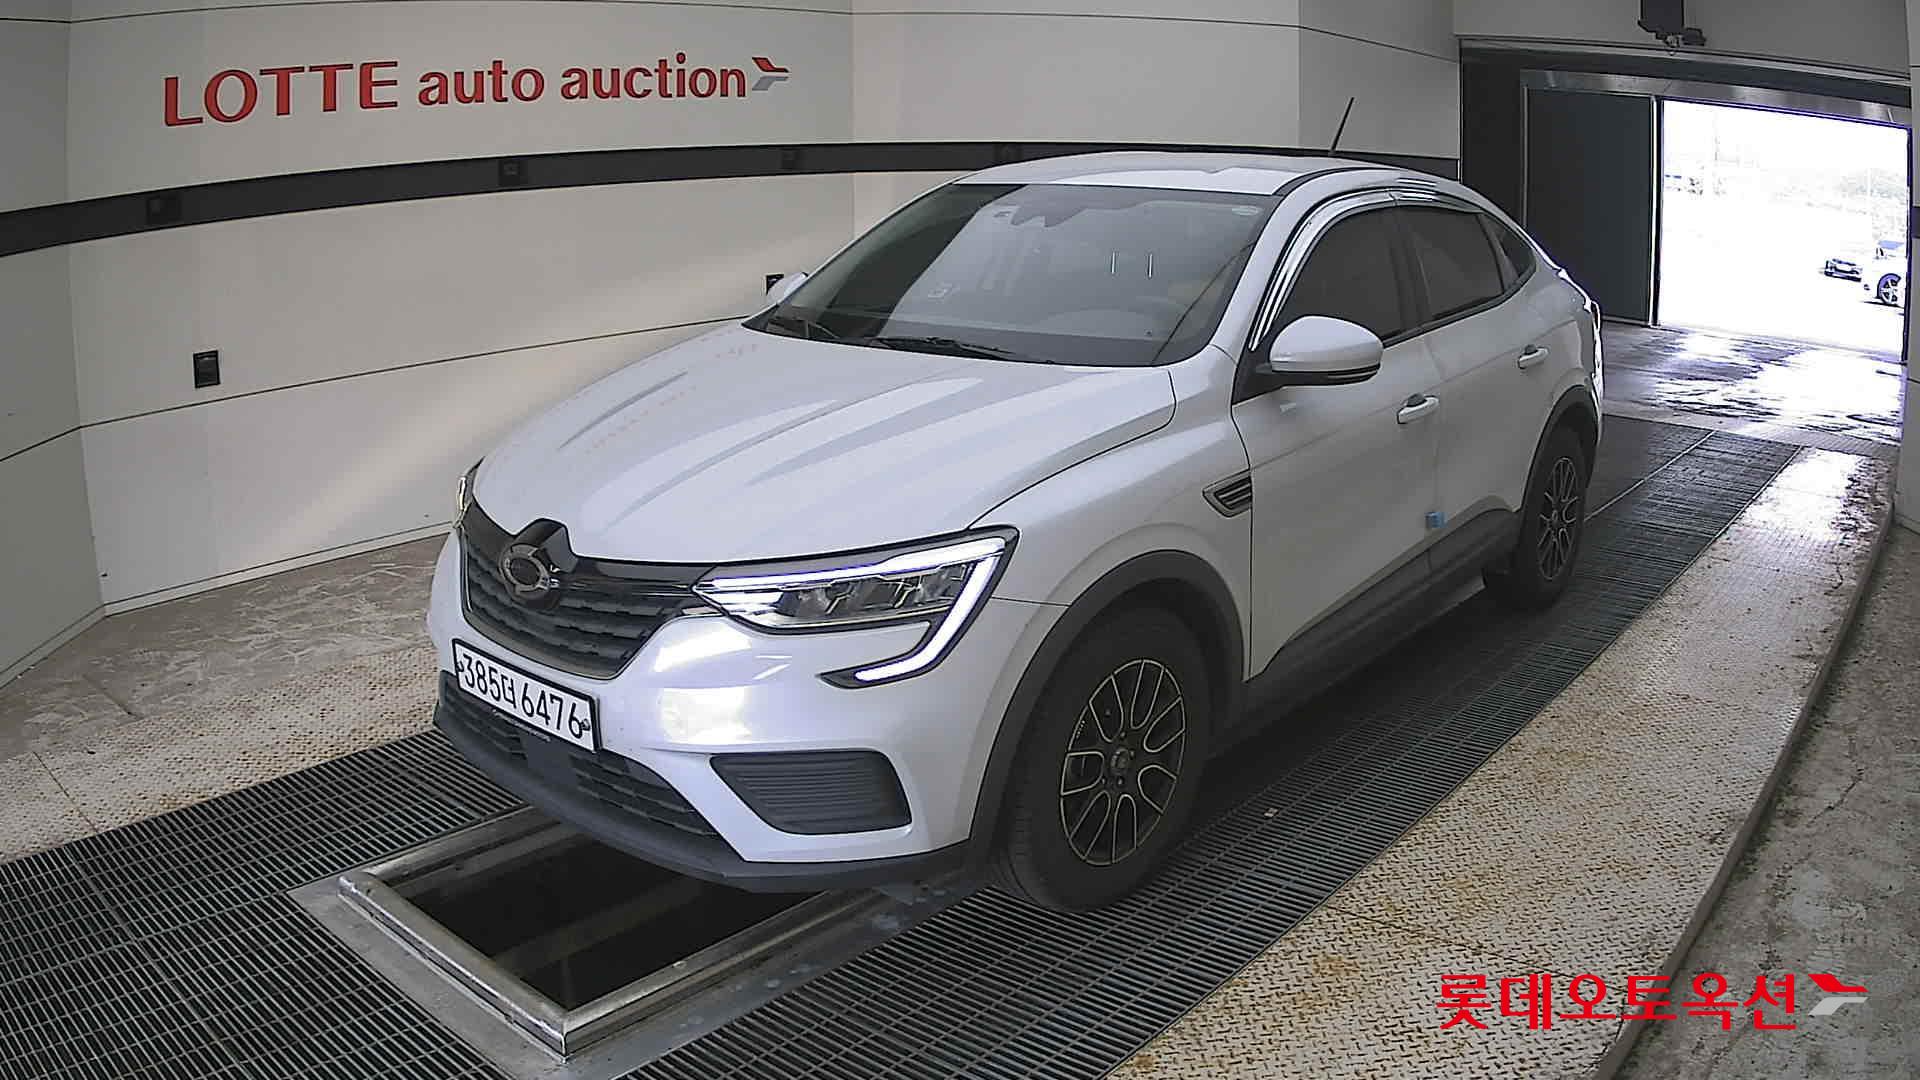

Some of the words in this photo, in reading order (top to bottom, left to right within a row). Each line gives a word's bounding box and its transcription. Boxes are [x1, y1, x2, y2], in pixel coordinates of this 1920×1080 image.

[164, 60, 399, 127] LOTTE
[417, 60, 545, 106] auto
[560, 52, 747, 100] auction
[521, 682, 584, 739] 6476
